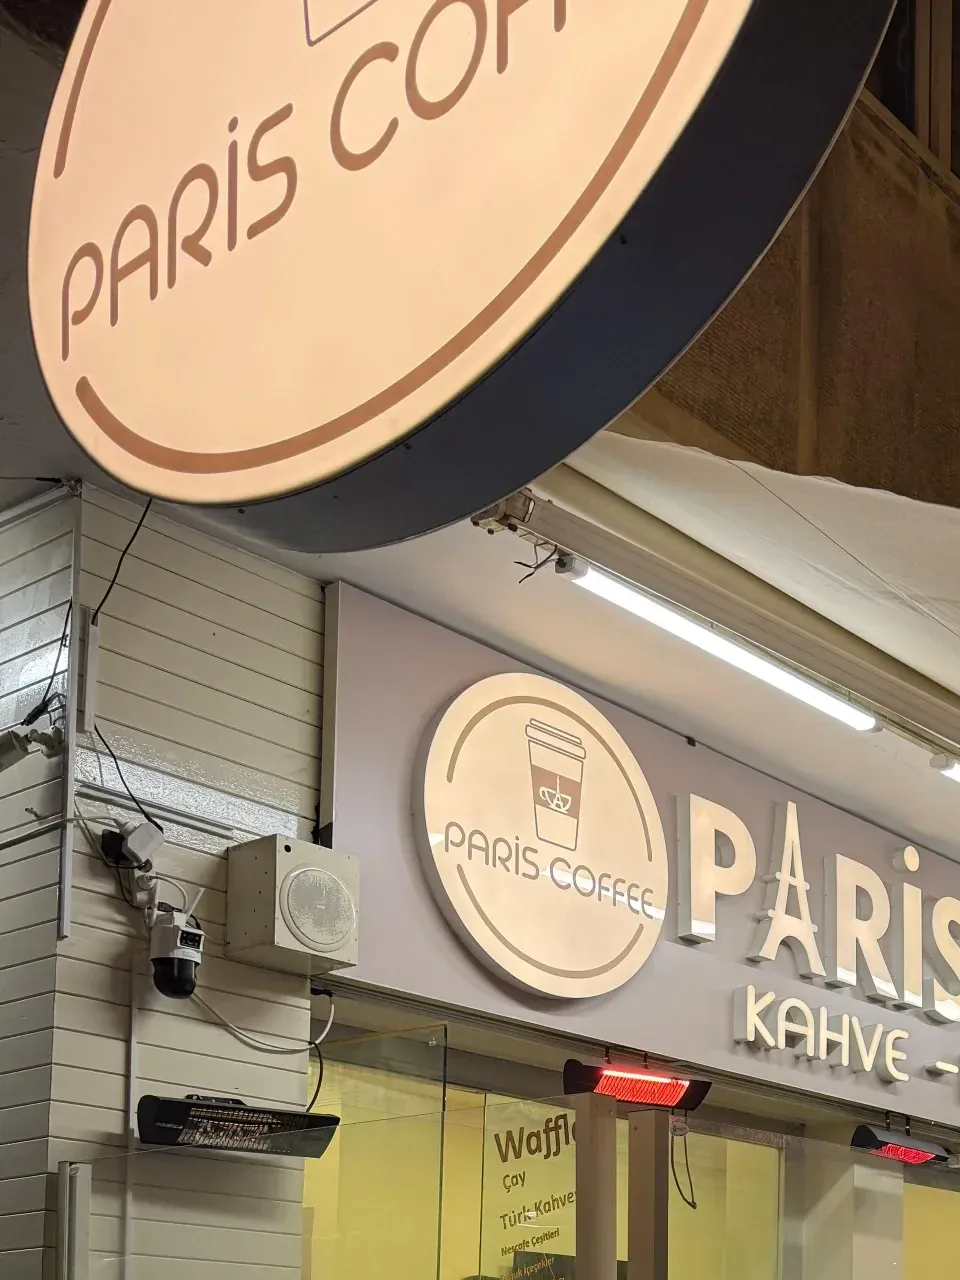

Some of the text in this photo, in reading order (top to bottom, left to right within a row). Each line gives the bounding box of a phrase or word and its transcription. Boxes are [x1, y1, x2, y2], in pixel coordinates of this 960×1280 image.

[550, 857, 654, 919] COFFEE
[744, 984, 910, 1082] KAHVE
[502, 1171, 526, 1193] Çay
[500, 1206, 531, 1230] Türk
